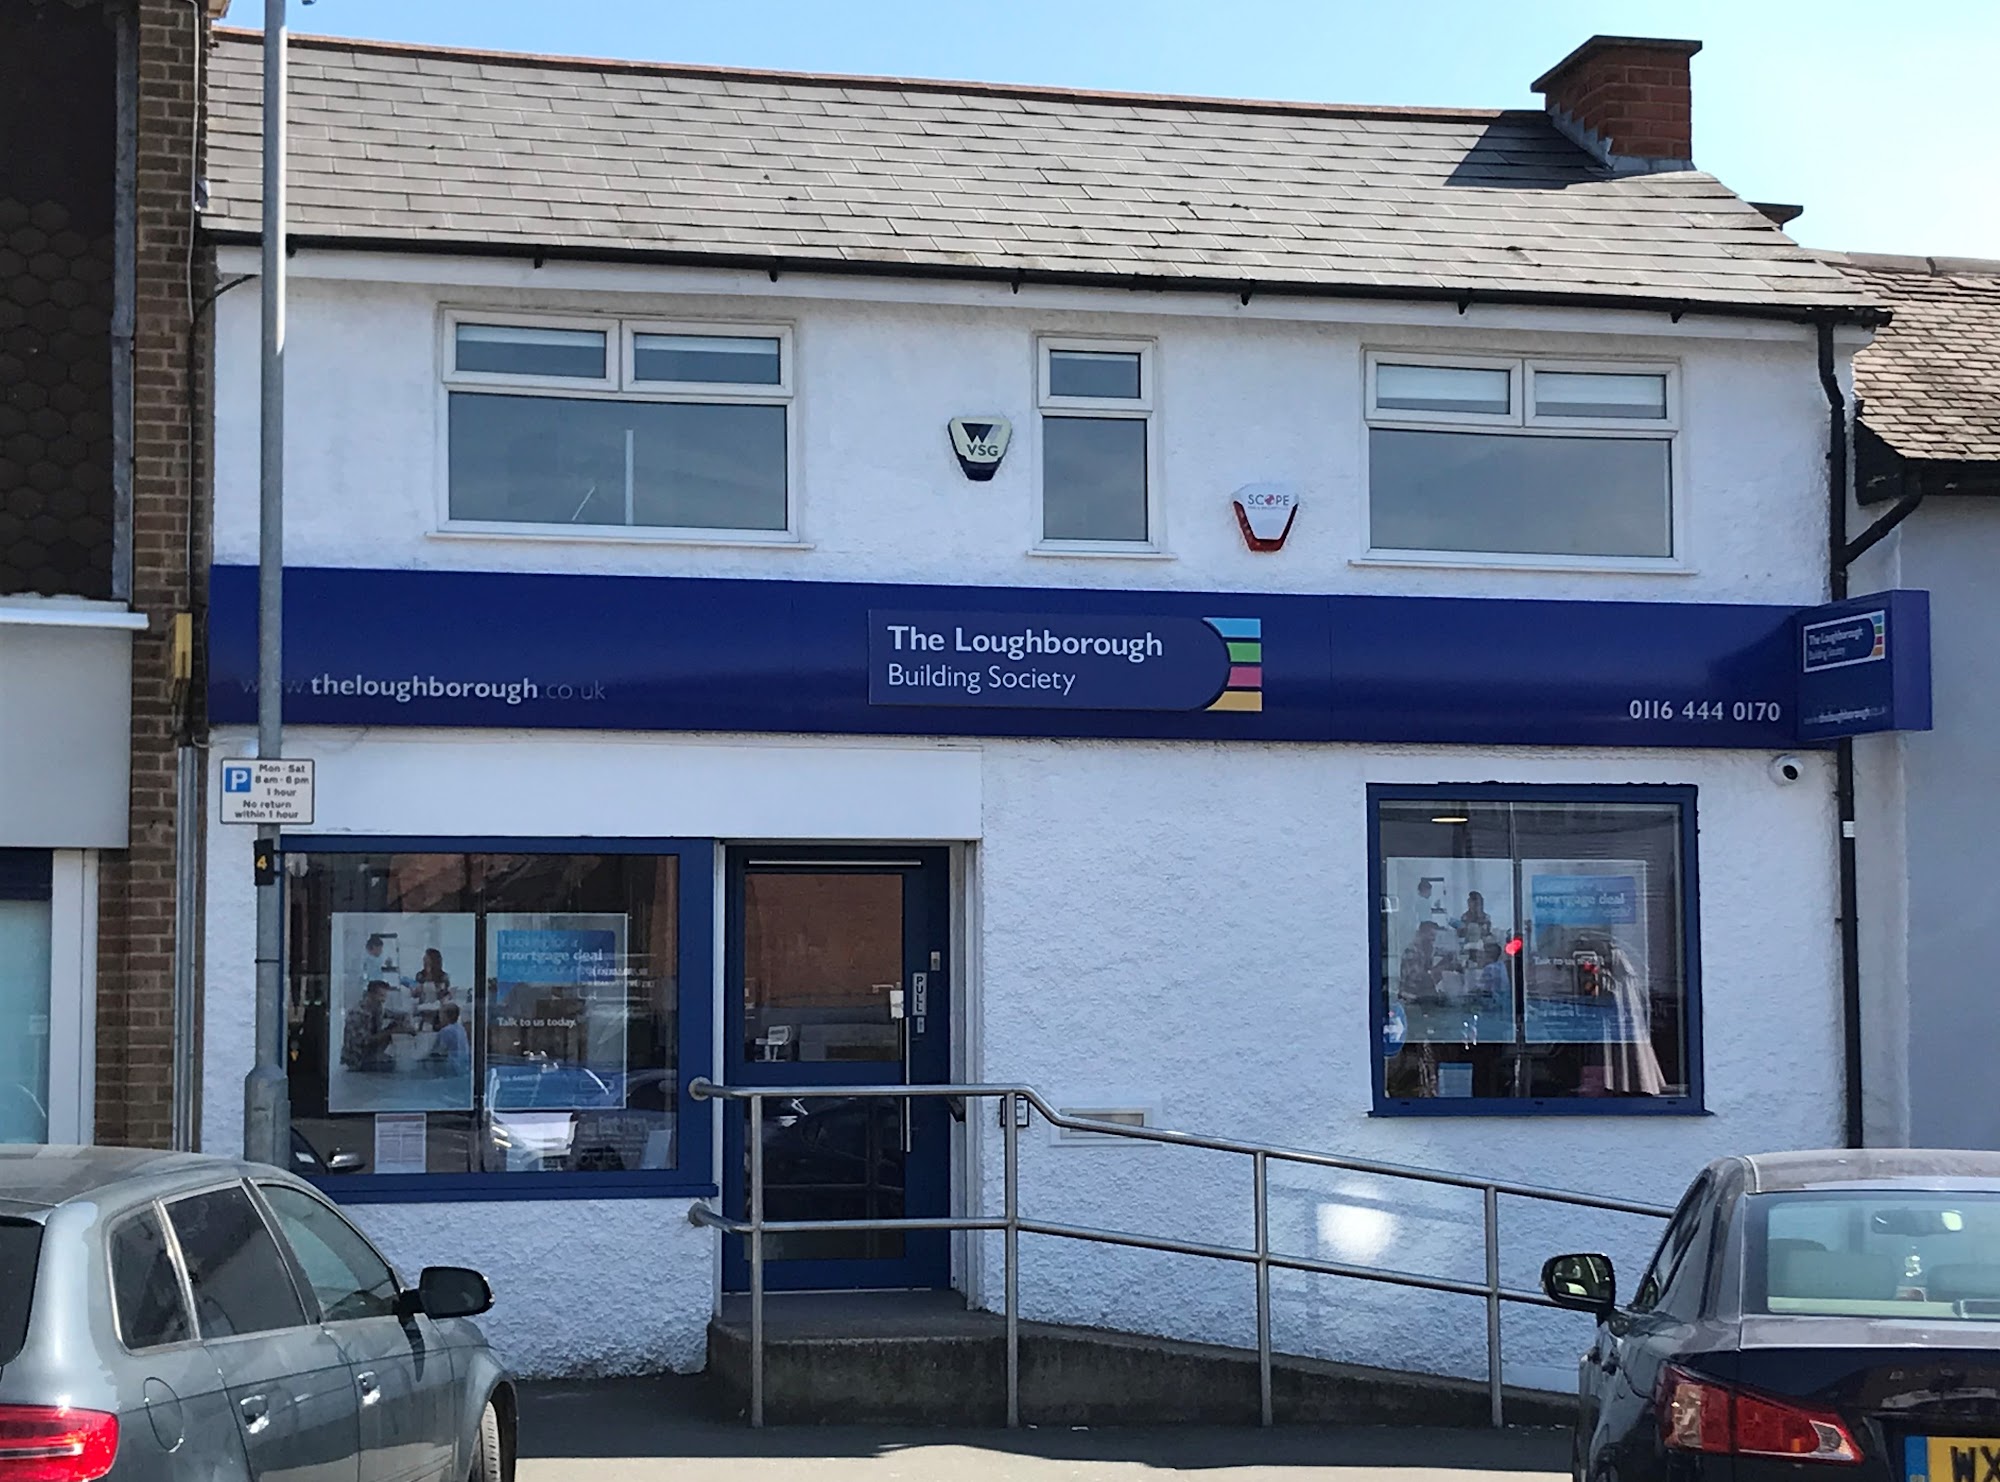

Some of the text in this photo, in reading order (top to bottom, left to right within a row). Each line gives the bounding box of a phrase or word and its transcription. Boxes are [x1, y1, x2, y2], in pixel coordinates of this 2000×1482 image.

[966, 444, 999, 457] VSG
[1247, 493, 1290, 506] SCOPE
[887, 625, 1163, 663] The Loughborough
[888, 663, 1076, 696] Building Society
[1629, 699, 1674, 720] 0116
[1681, 701, 1724, 721] 444
[1732, 701, 1781, 722] 0170
[258, 764, 281, 773] Mon
[287, 764, 306, 773] Sat
[230, 769, 248, 791] P
[273, 788, 297, 797] hour
[242, 800, 292, 809] No return
[234, 810, 266, 819] within
[275, 810, 299, 819] hour
[256, 855, 268, 870] 4
[501, 948, 604, 965] mortgage deal
[916, 975, 924, 1013] PULL
[498, 1017, 518, 1027] Talk
[519, 1018, 531, 1027] to
[533, 1018, 545, 1027] us
